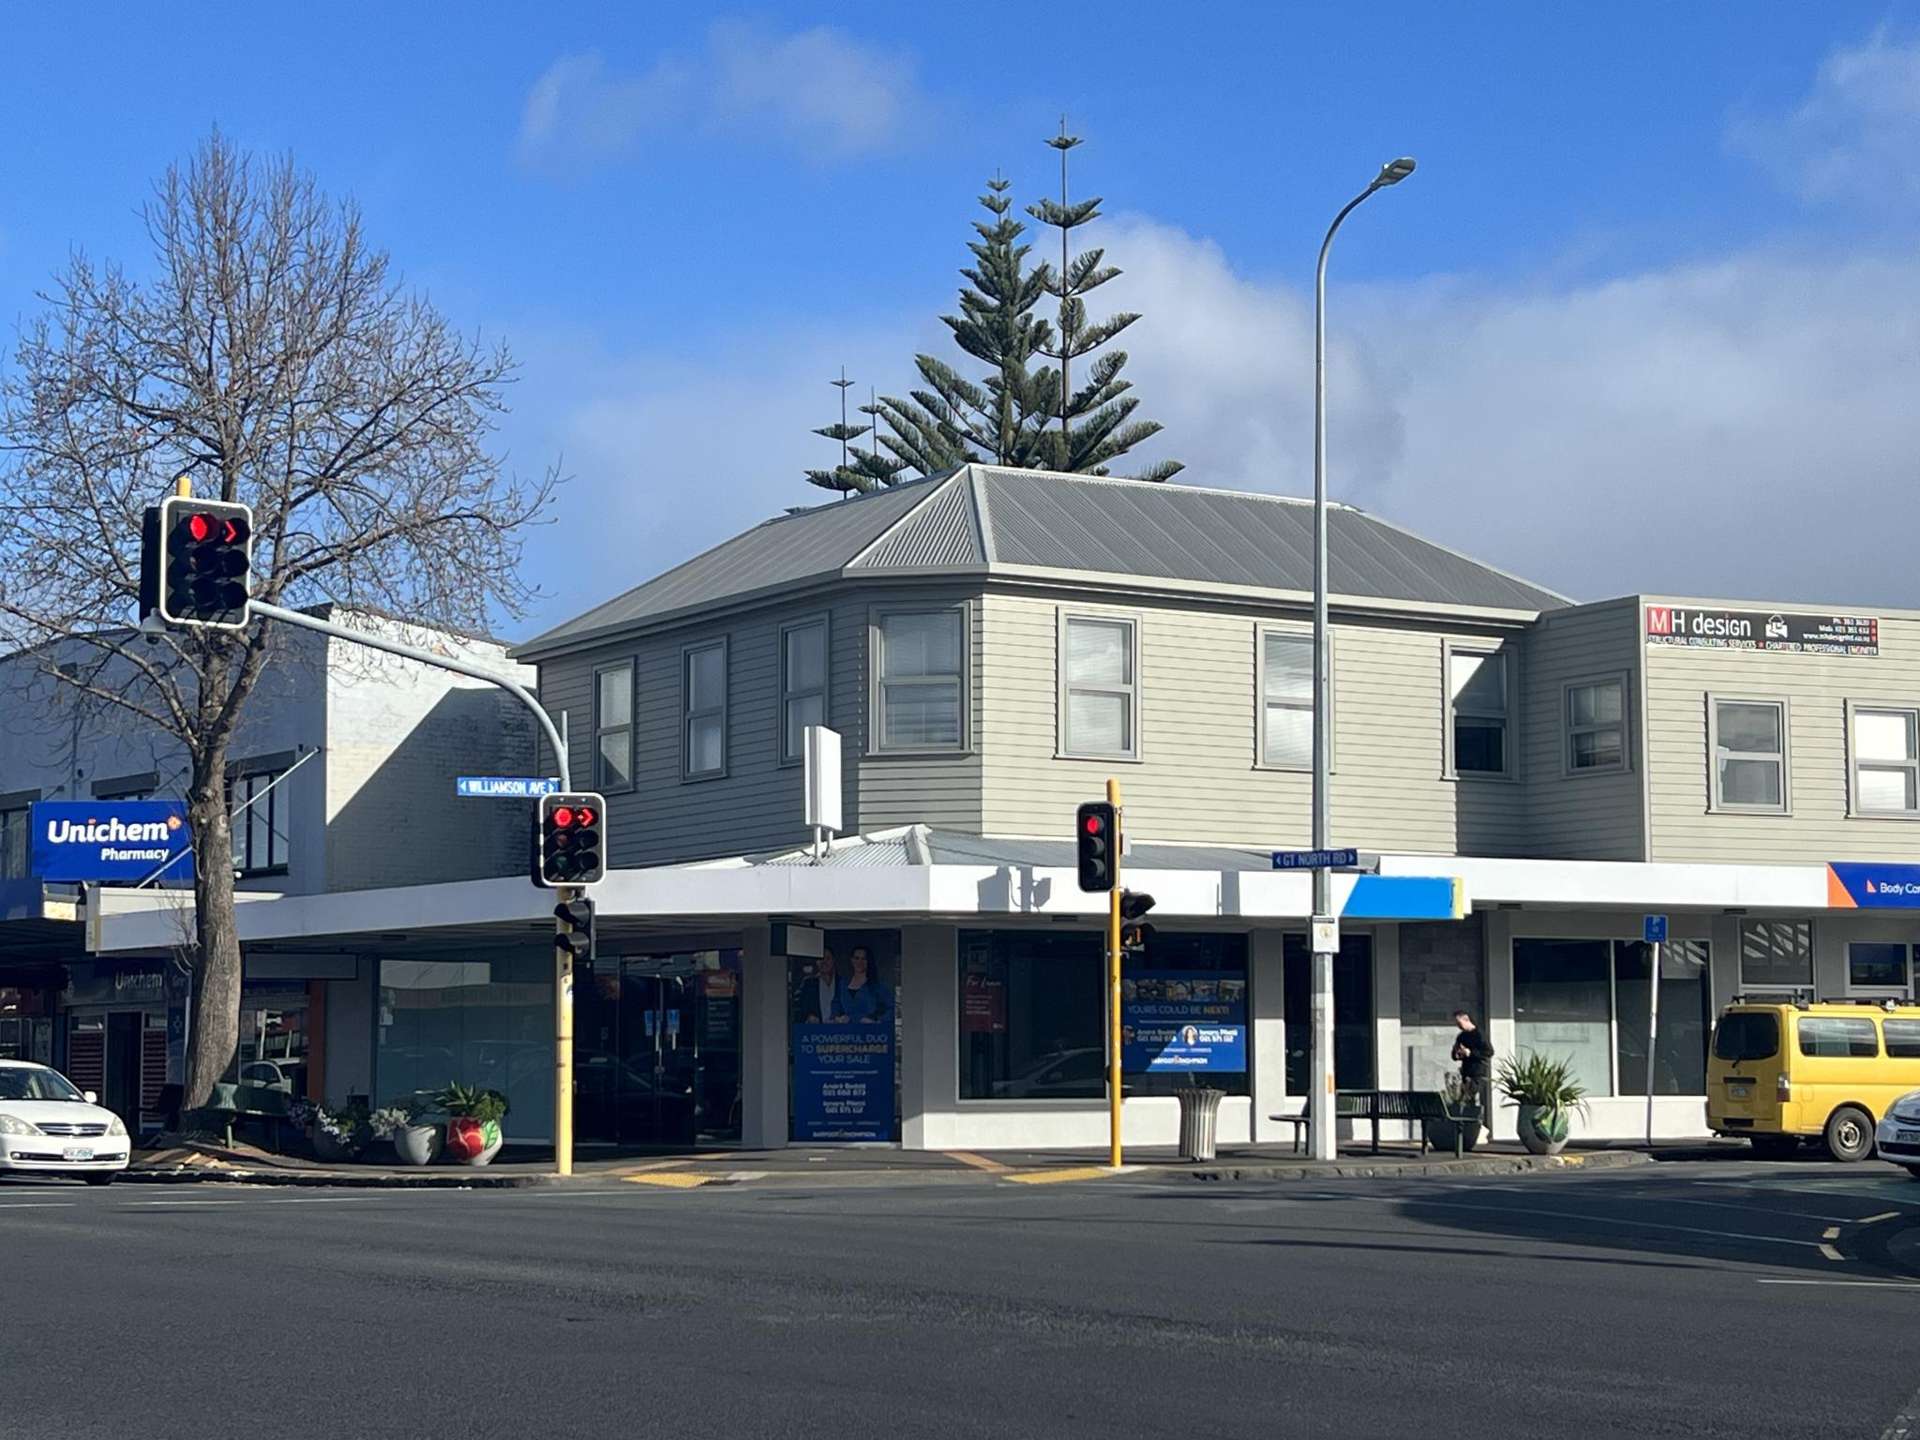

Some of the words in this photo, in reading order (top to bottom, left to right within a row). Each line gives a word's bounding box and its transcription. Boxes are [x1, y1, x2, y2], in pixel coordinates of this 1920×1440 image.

[1651, 610, 1685, 633] MH
[1648, 635, 1687, 646] STRUCTURAL
[1689, 637, 1727, 648] CONSULTING
[1728, 639, 1756, 649] SERVICES
[468, 780, 526, 794] WILLIAMSON
[529, 781, 547, 794] AVE
[48, 817, 169, 843] Unichem
[101, 848, 169, 862] Pharmacy
[1283, 854, 1295, 866] GT
[1298, 852, 1331, 866] NORTH
[1333, 852, 1346, 864] RD
[1880, 882, 1904, 895] Body
[1128, 1006, 1158, 1015] YOURS
[1160, 1006, 1188, 1015] COULD
[1190, 1006, 1200, 1015] BE
[1204, 1006, 1230, 1015] NEXT!
[811, 1034, 862, 1043] POWERFUL
[866, 1034, 887, 1043] DUO
[801, 1045, 814, 1053] TO
[816, 1045, 888, 1053] SUPERCHARGE
[818, 1055, 844, 1064] YOUR
[846, 1055, 870, 1064] SALE
